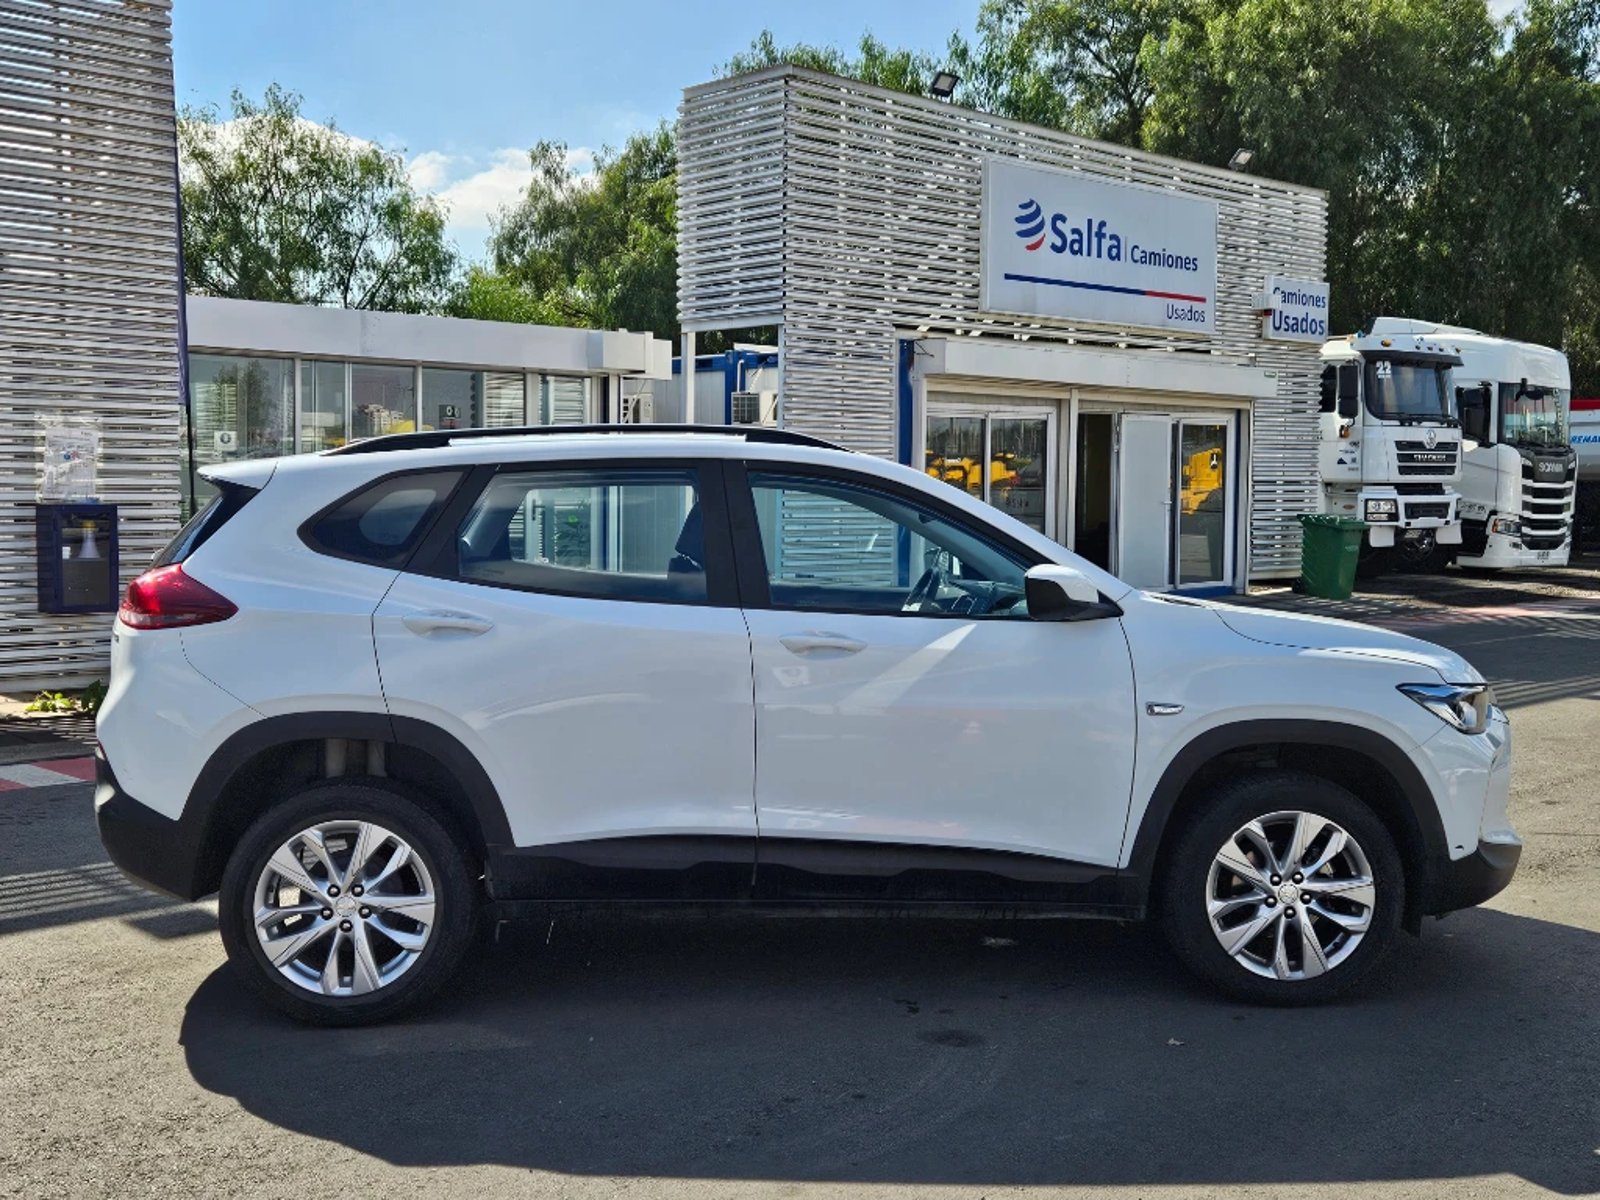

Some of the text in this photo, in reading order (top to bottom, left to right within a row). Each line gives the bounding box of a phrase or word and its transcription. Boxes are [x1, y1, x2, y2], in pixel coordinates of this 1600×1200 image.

[1050, 213, 1198, 272] Salfa Camiones
[1167, 304, 1206, 322] Usados
[1272, 309, 1325, 335] Usados
[1375, 360, 1392, 374] 22
